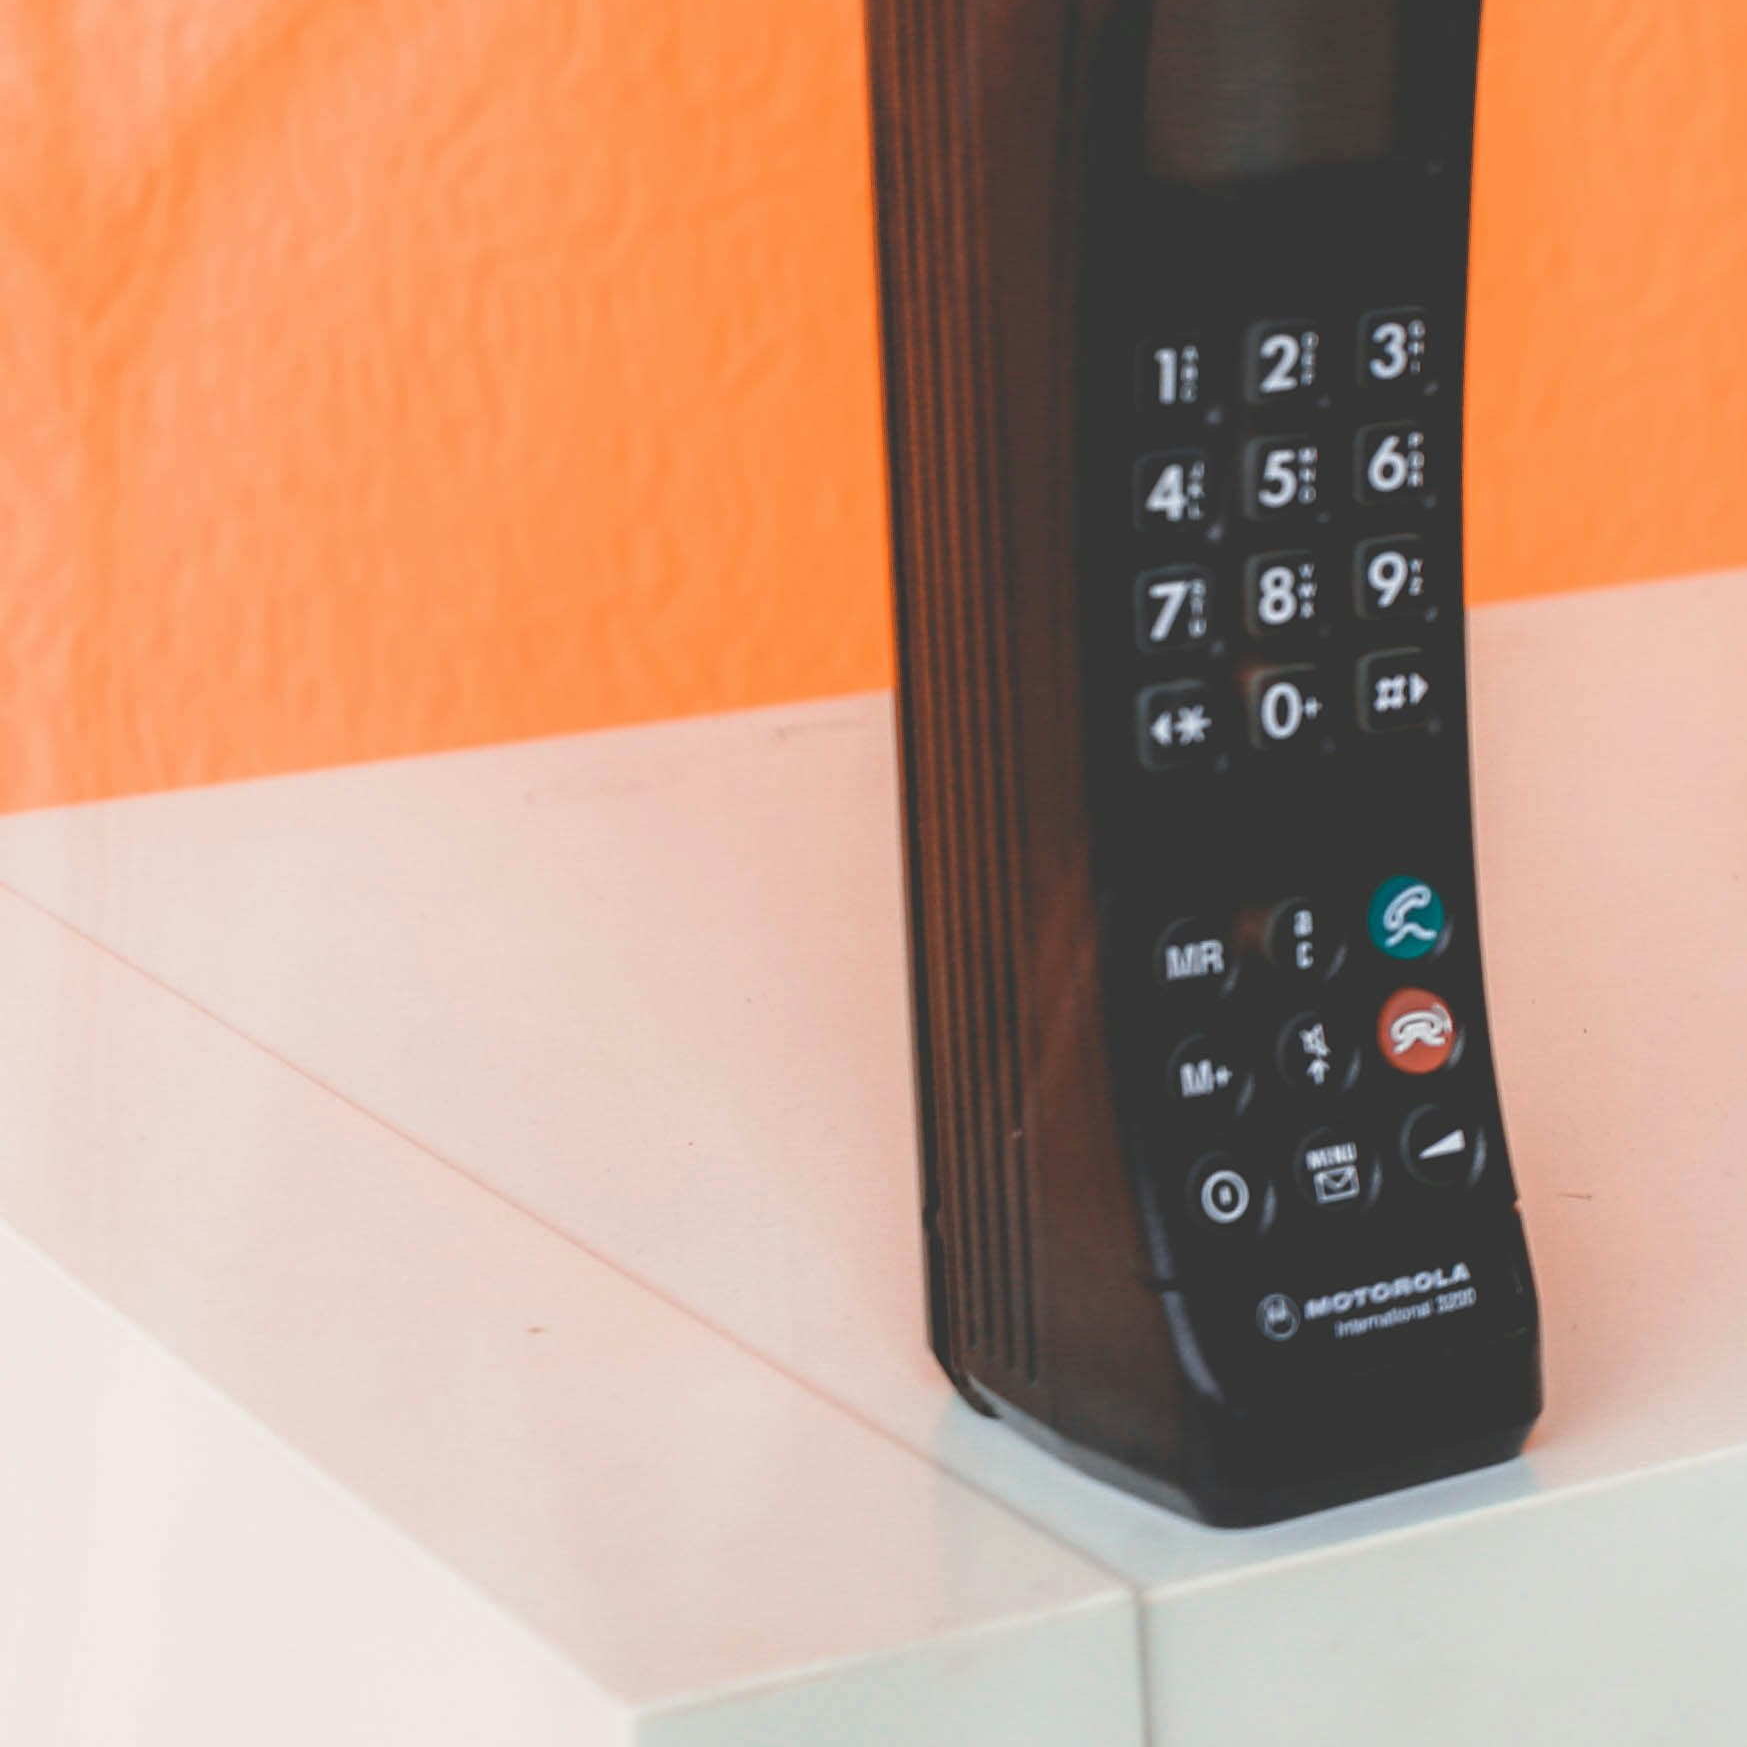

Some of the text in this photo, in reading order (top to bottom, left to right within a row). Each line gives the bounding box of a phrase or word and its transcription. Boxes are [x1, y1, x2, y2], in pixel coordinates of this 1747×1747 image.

[1154, 348, 1177, 404] 1
[1260, 334, 1300, 395] 2
[1369, 322, 1407, 380] 3
[1258, 450, 1297, 508] 5
[1368, 435, 1407, 492] 6
[1146, 464, 1185, 522] 4
[1258, 566, 1297, 625] 8
[1368, 551, 1408, 609] 9
[1149, 581, 1187, 642] 7
[1166, 940, 1224, 980] MR
[1181, 1059, 1233, 1097] M+
[1303, 1262, 1470, 1320] MOTOROLA
